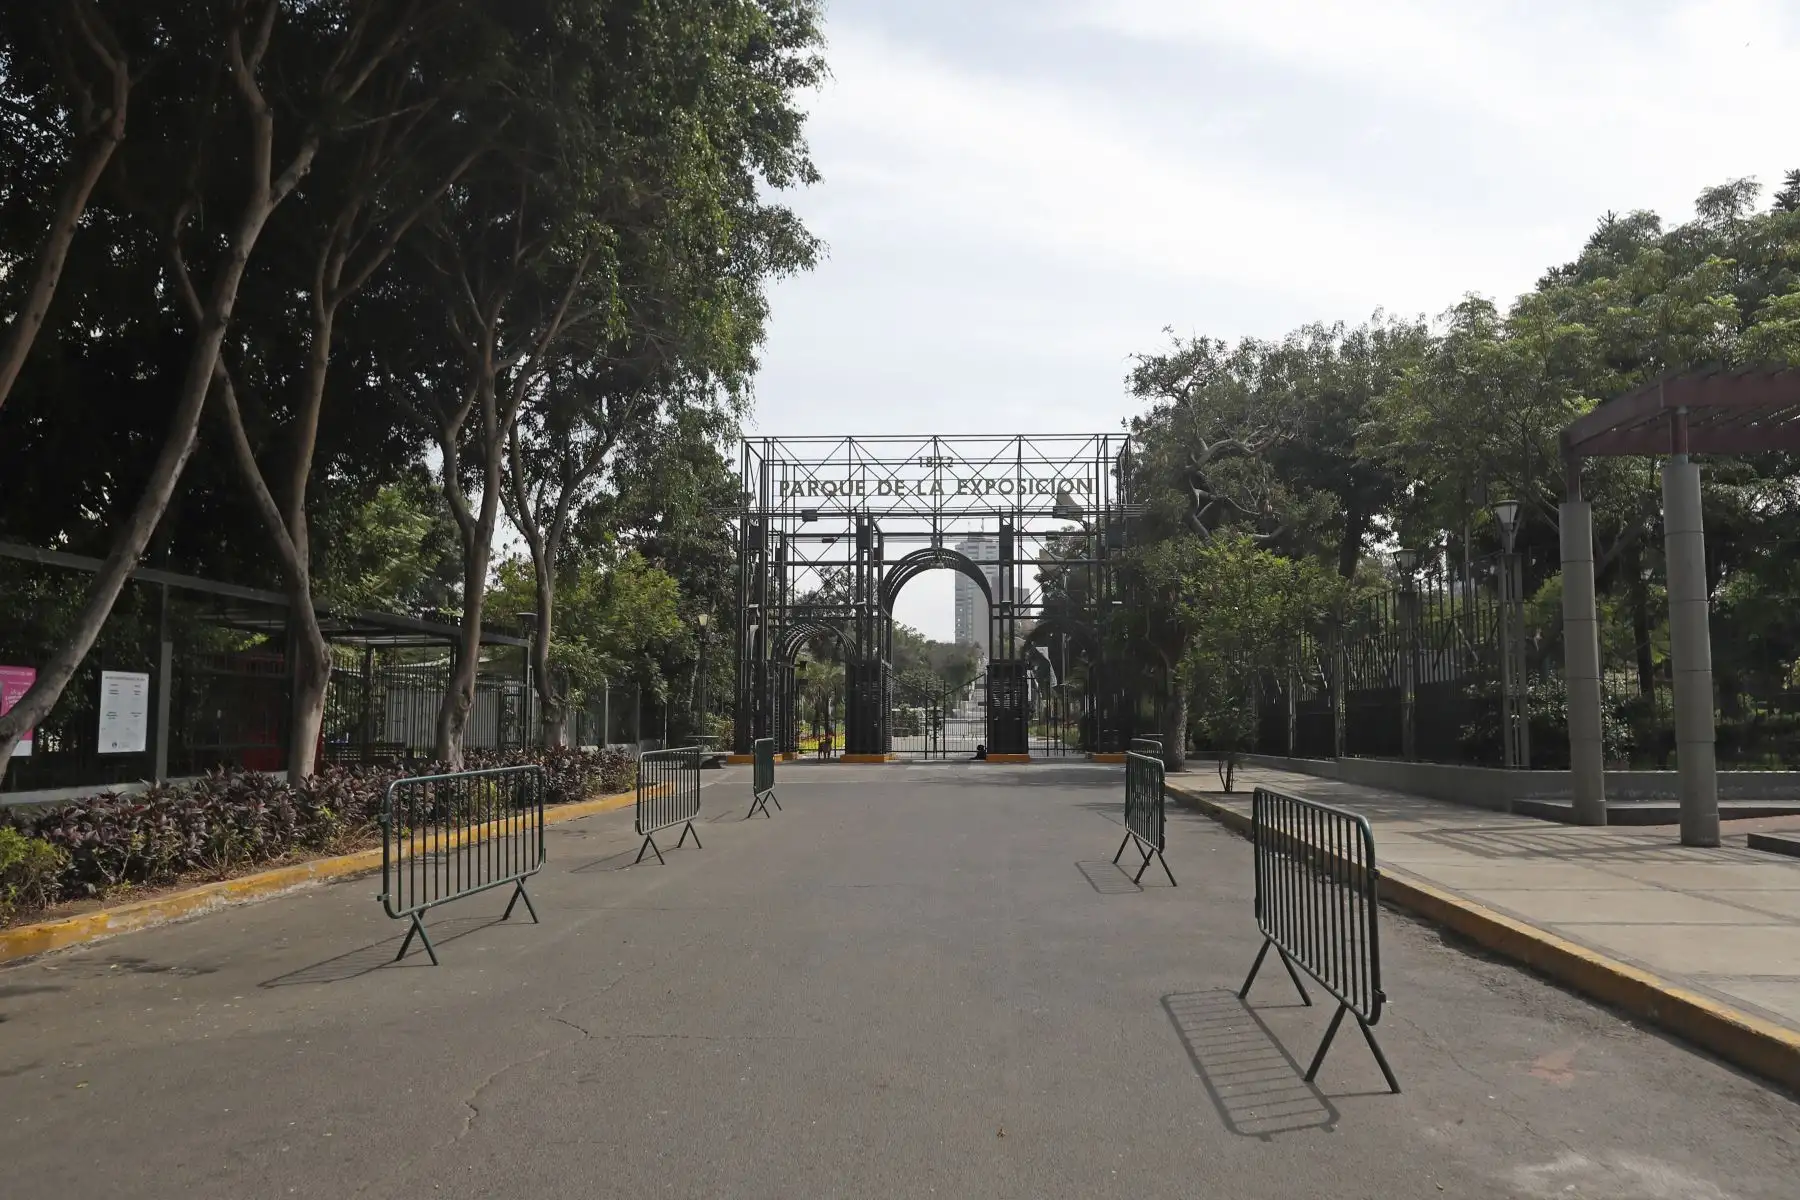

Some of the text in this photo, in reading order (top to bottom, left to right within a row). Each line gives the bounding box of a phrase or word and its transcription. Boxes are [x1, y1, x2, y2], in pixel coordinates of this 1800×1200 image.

[779, 478, 1093, 496] PARQUE DE LA EXPOSICION
